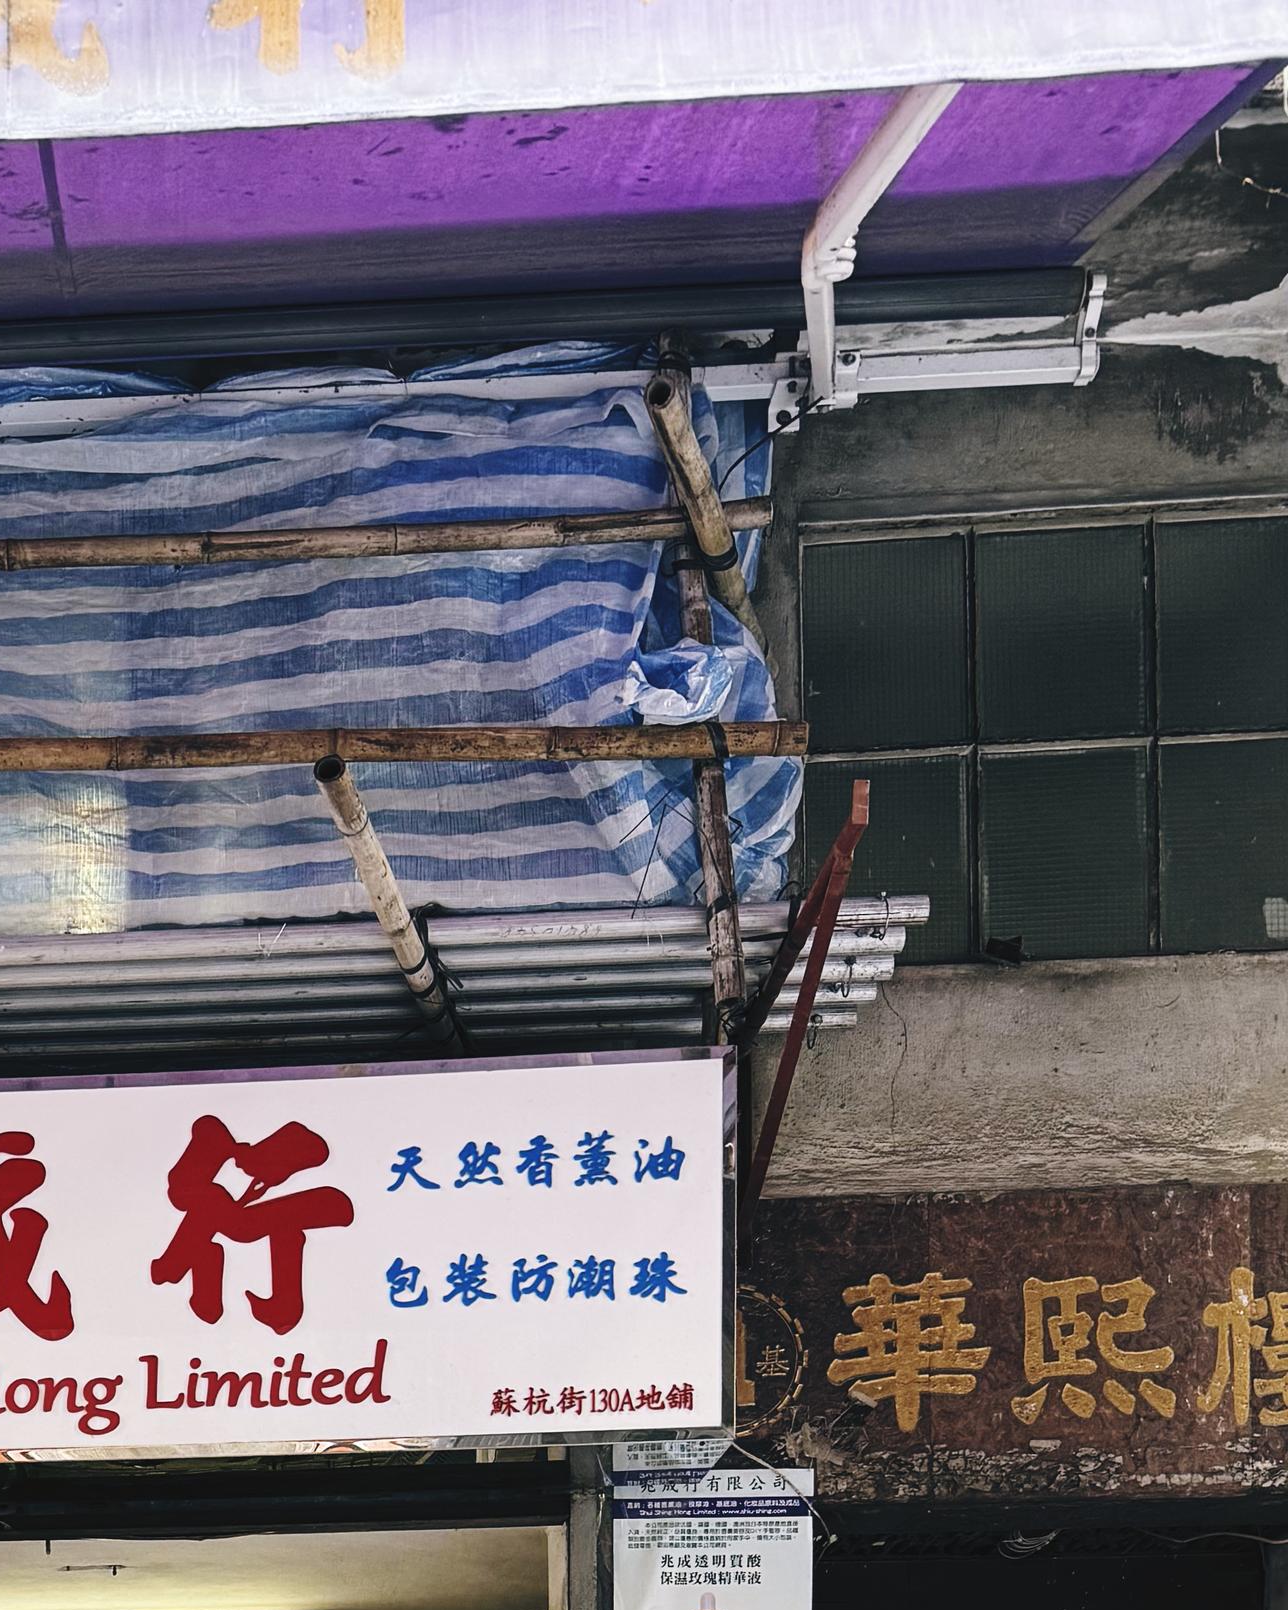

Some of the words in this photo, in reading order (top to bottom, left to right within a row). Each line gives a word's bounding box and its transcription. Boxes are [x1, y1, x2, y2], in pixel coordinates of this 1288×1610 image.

[386, 1130, 687, 1193] 天然香薰油
[385, 1252, 688, 1308] 包裝防潮珠
[139, 1338, 391, 1411] Limited
[661, 1554, 762, 1569] 兆成透明質酸
[661, 1571, 762, 1585] 保濕玫瑰精華液
